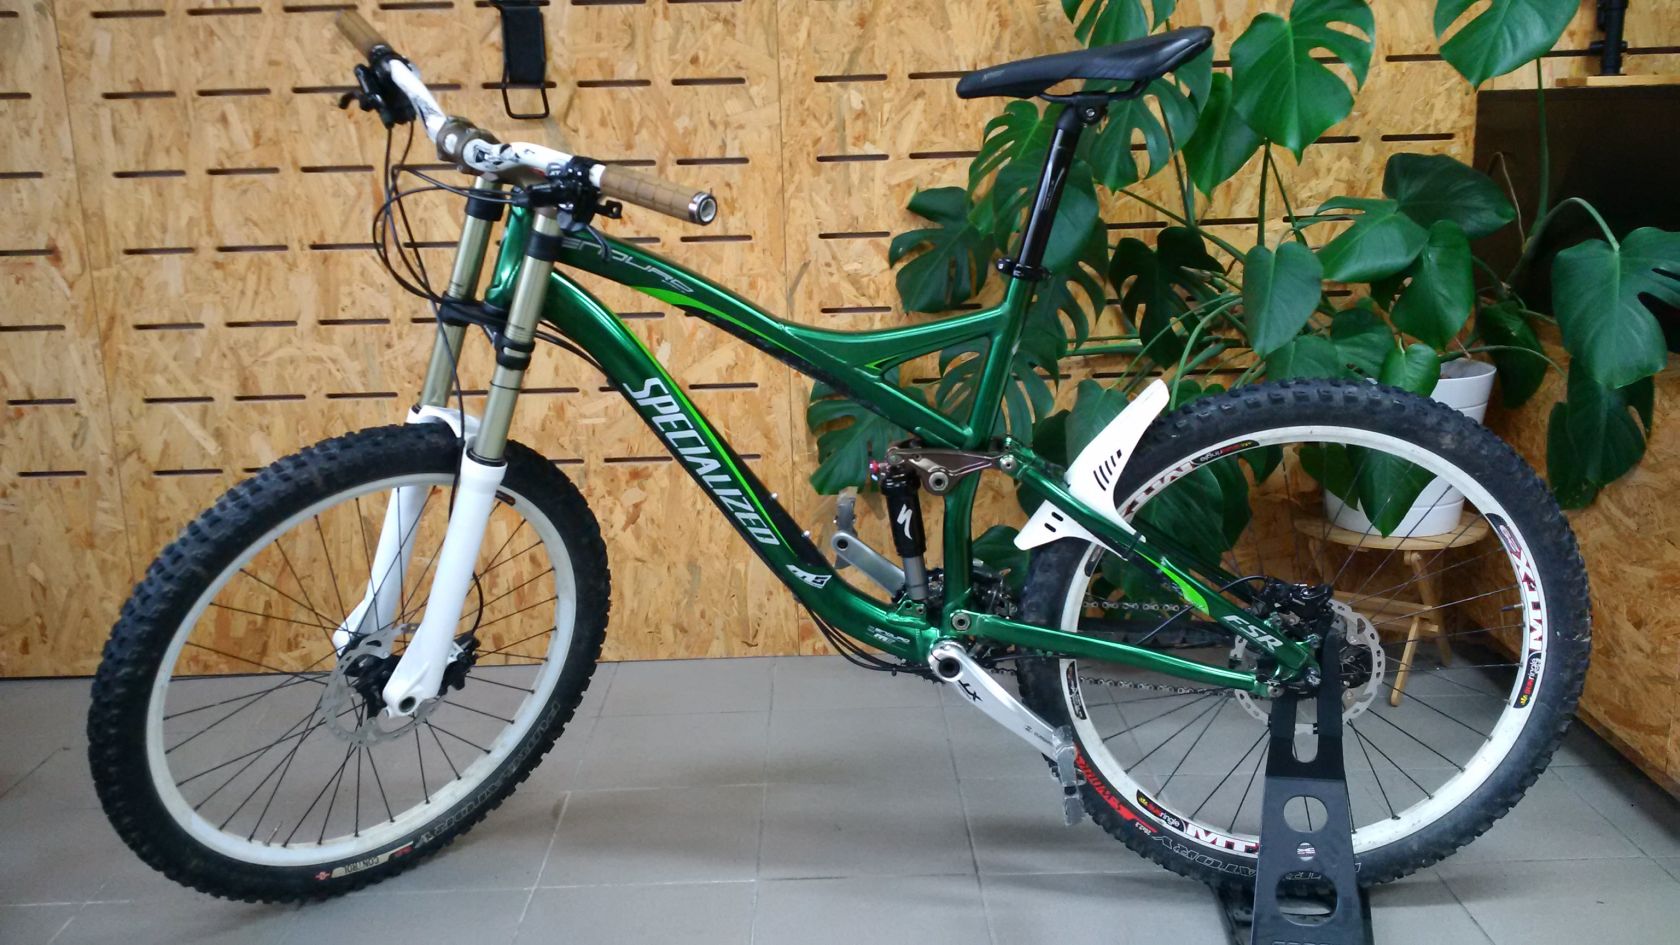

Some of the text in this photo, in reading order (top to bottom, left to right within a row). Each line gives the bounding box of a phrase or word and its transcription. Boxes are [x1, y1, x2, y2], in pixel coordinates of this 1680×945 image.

[622, 377, 780, 545] SPECIALIZED
[1223, 614, 1283, 652] FSR
[1514, 549, 1543, 651] MTX
